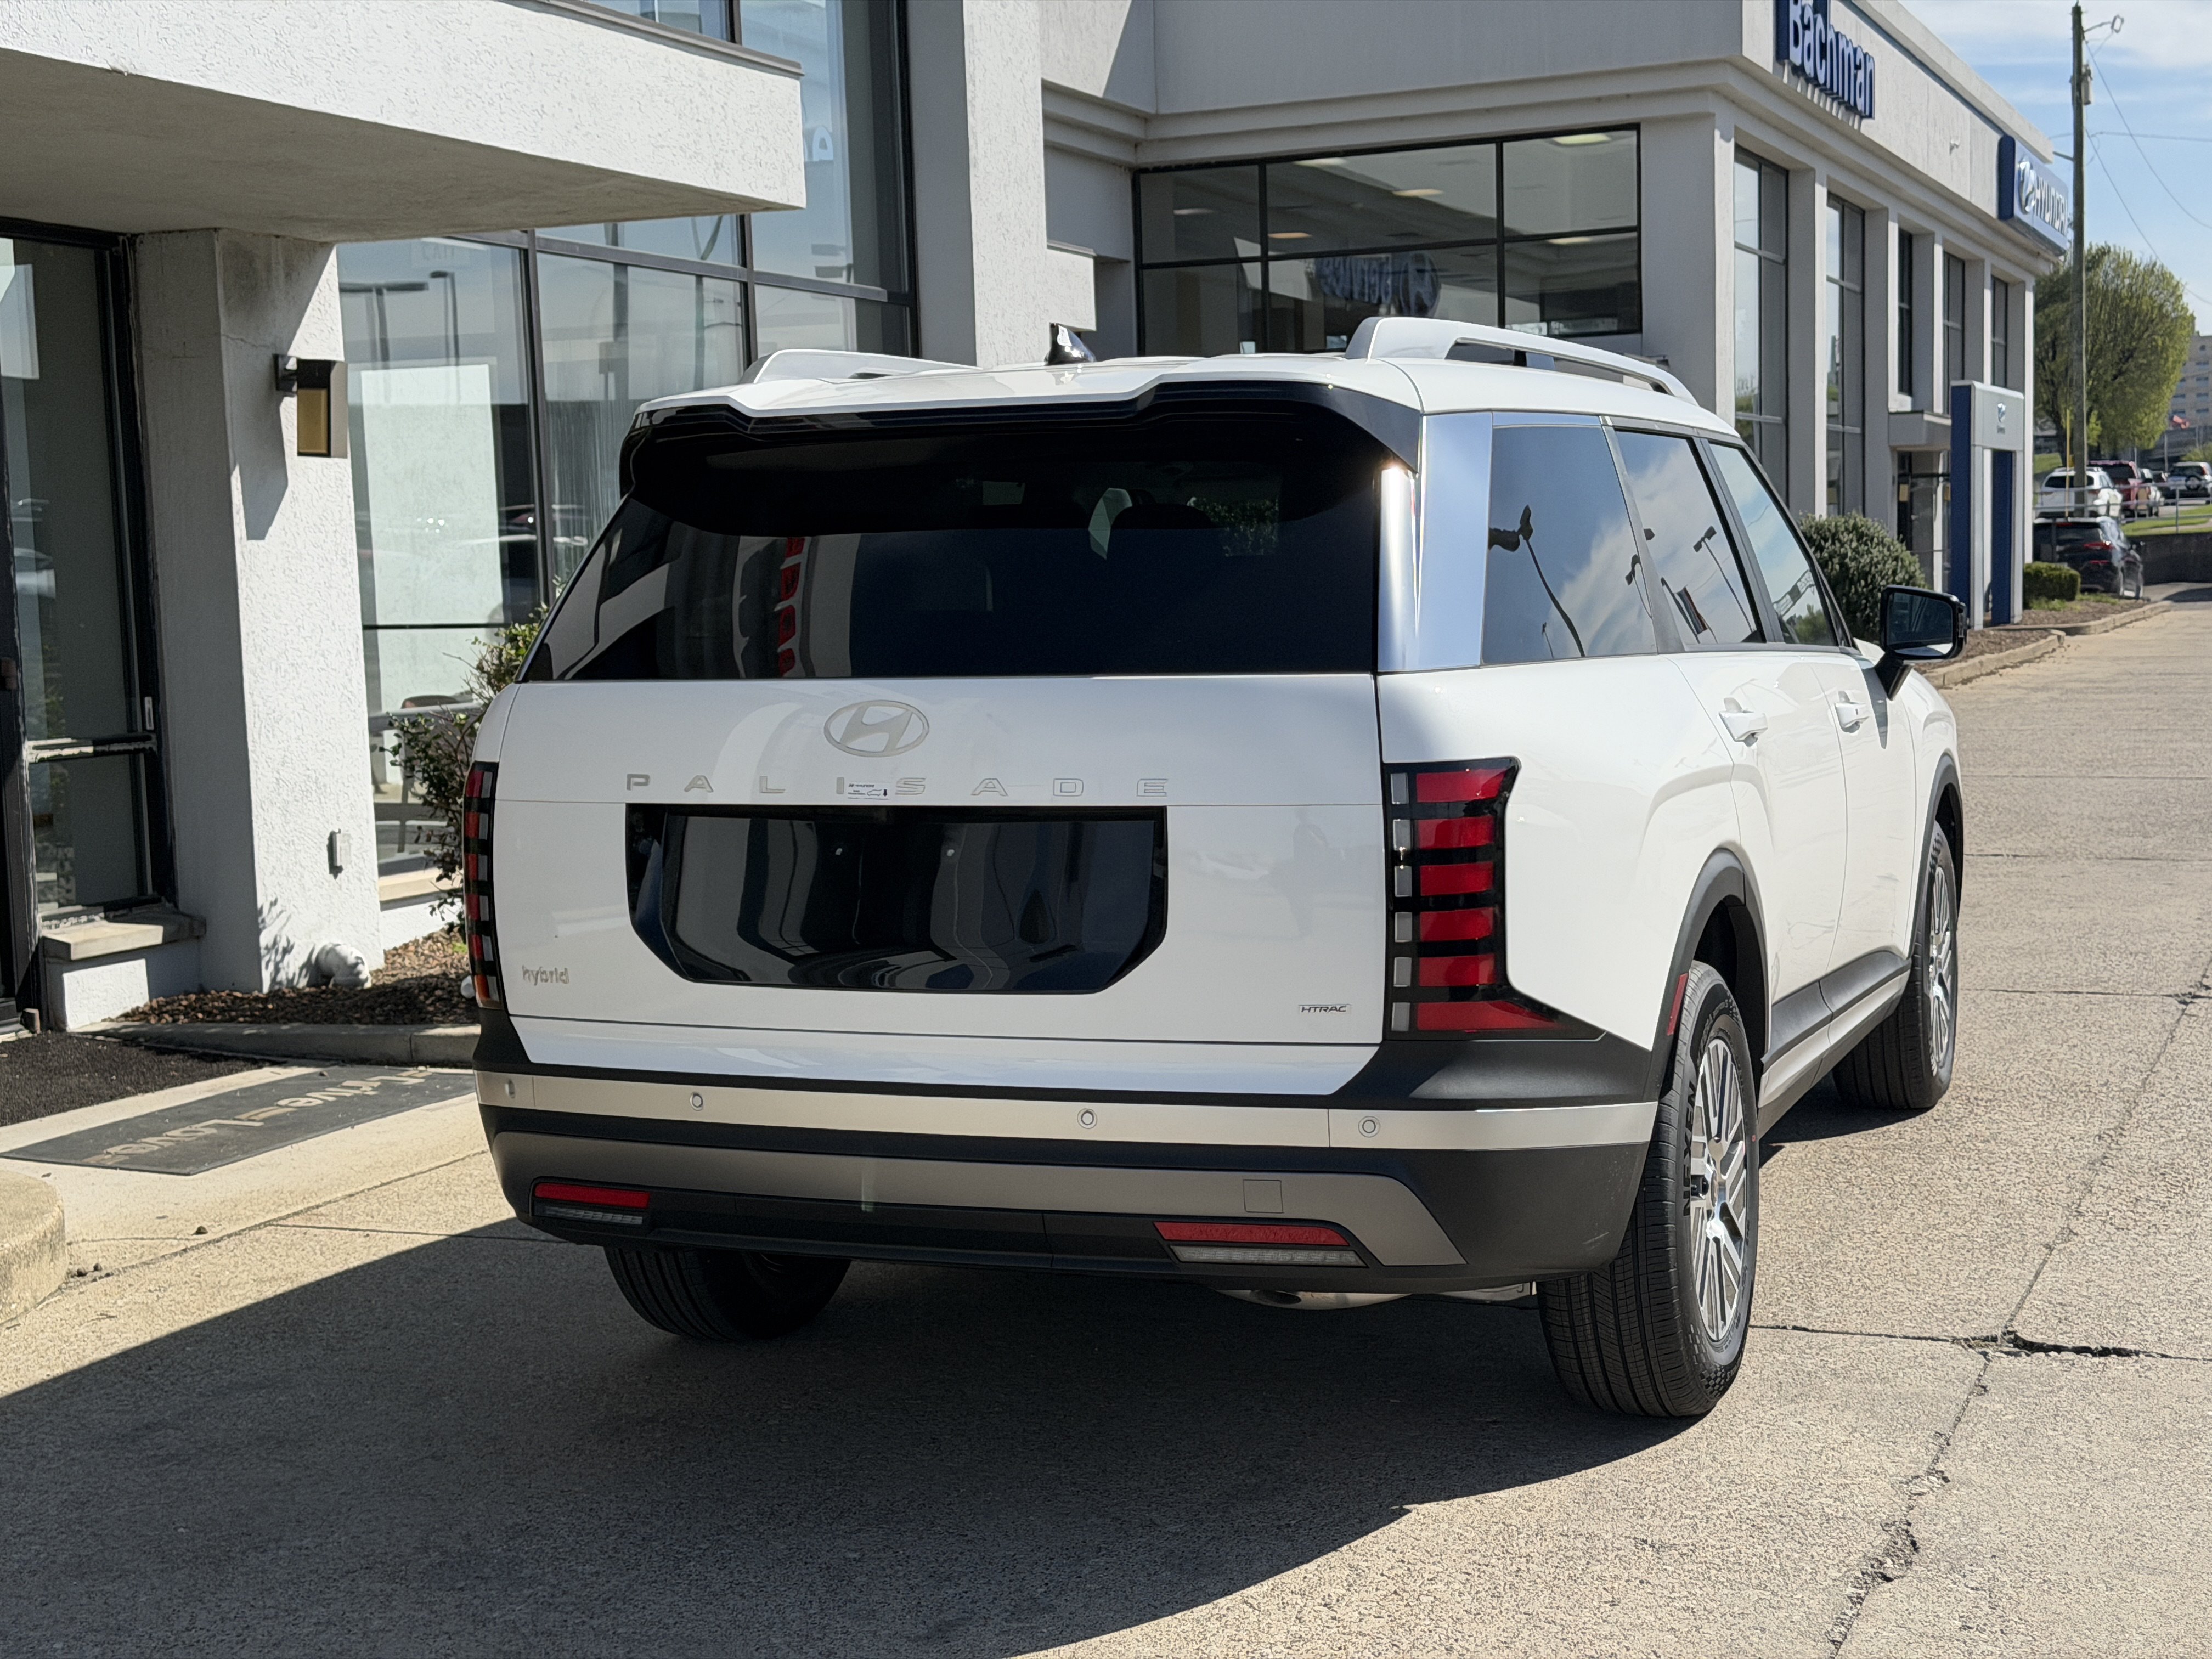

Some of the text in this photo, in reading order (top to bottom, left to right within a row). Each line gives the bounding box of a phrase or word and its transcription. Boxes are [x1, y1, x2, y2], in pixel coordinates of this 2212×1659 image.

[1789, 0, 1874, 119] Bachman
[626, 774, 1169, 797] PALISADE
[522, 965, 569, 986] hybrid
